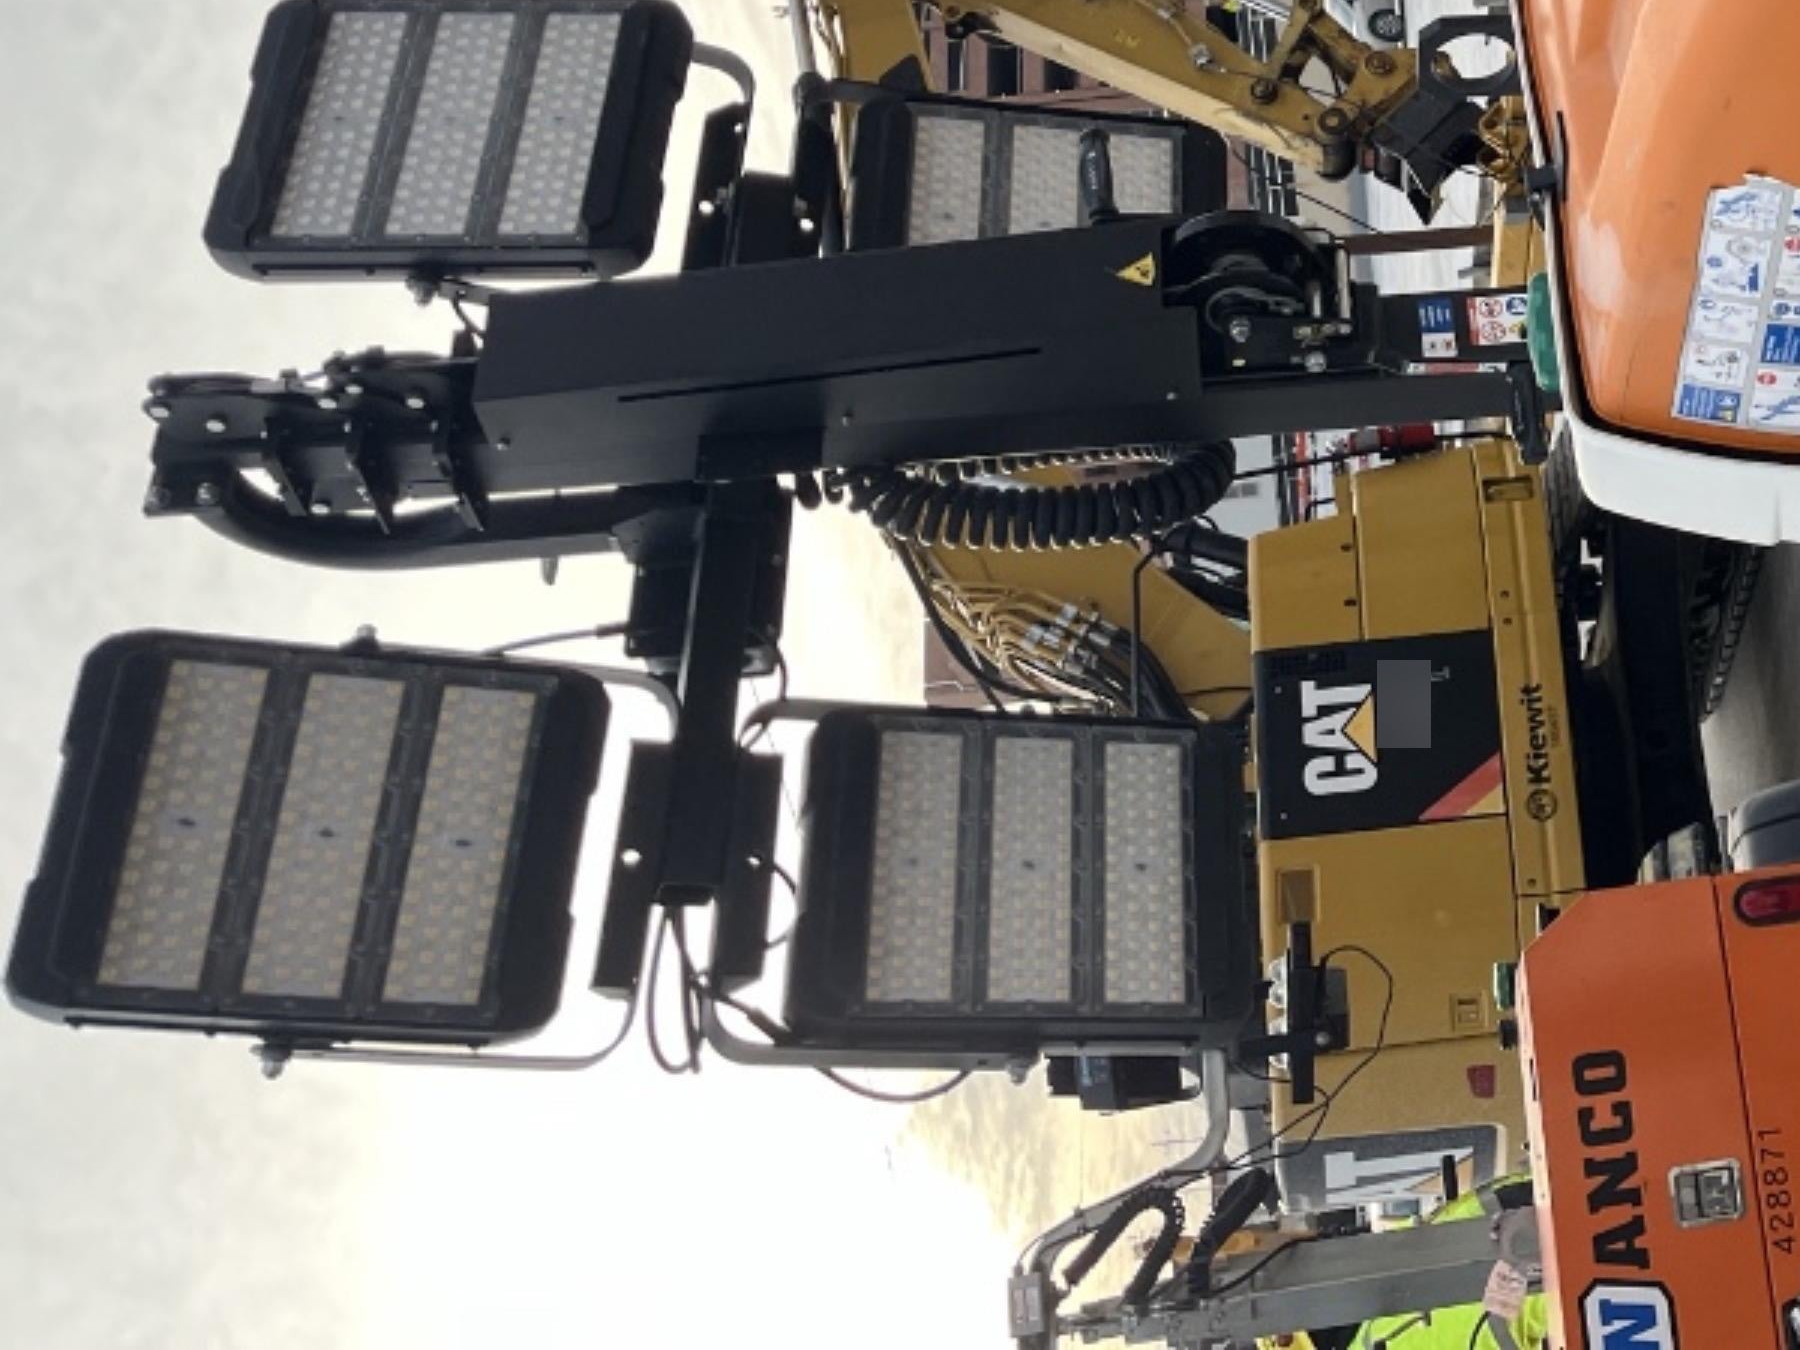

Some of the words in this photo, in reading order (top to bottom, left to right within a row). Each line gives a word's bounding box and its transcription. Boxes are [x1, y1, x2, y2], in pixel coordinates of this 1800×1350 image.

[1301, 680, 1378, 795] CAT
[1519, 683, 1551, 785] Kiewit
[1325, 1147, 1474, 1206] AT
[1757, 1127, 1796, 1254] 428871
